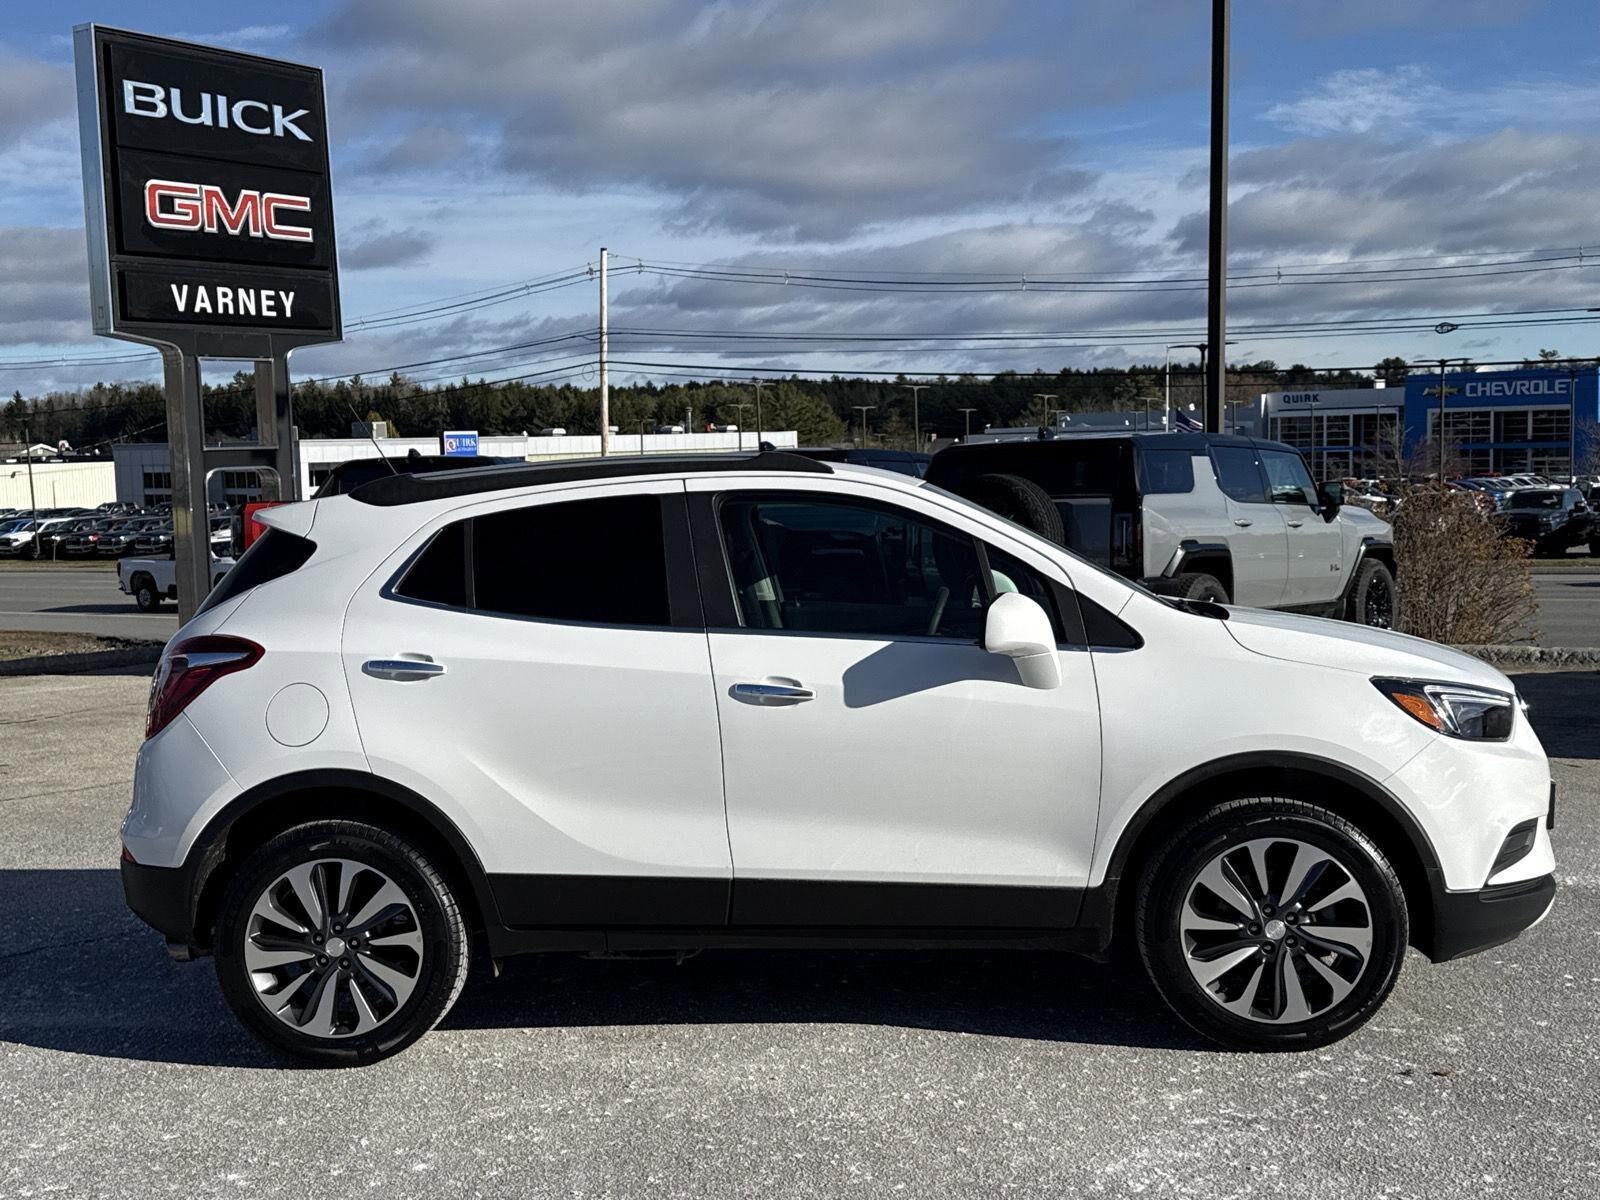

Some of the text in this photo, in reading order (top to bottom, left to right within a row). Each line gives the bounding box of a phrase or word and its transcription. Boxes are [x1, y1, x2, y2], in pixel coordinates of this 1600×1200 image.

[122, 79, 313, 142] BUICK
[145, 179, 313, 242] GMC
[170, 283, 295, 318] VARNEY
[1282, 393, 1320, 404] QUIRK
[1465, 378, 1579, 397] CHEVROLET
